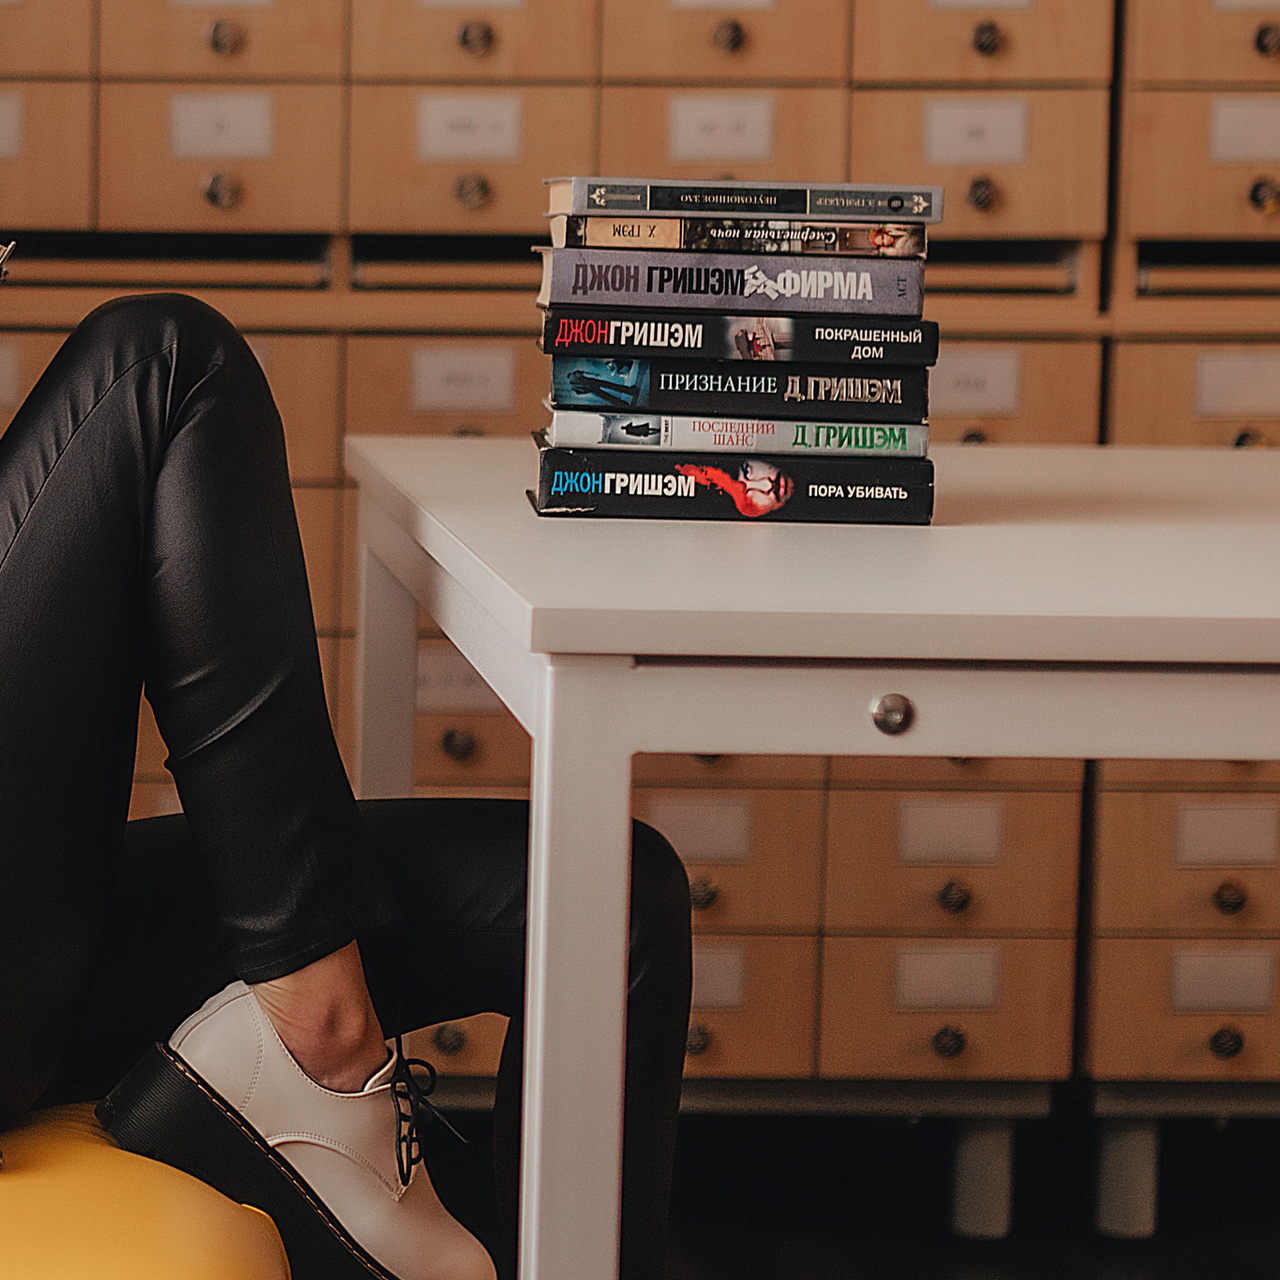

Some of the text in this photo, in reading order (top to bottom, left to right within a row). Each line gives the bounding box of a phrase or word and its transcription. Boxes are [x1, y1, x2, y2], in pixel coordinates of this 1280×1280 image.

[680, 195, 777, 205] НЕУГОМОННОЕ ЗЛО
[612, 224, 641, 238] ГРЭМ
[709, 227, 836, 244] Смертельная ночь
[572, 263, 746, 296] ДЖОН ГРИШЭМ
[777, 269, 873, 301] ФИРМА
[555, 318, 703, 349] ДЖОН ГРИШЭМ
[814, 327, 922, 344] ПОКРАШЕННЫЙ
[851, 345, 884, 360] ДОМ
[659, 373, 778, 394] ПРИЗНАНИЕ
[692, 420, 775, 435] ПОСЛЕДНИЙ
[713, 433, 754, 447] ШАНС
[550, 471, 696, 497] ДЖОН ГРИШЭМ
[808, 484, 908, 500] ПОРА УБИВАТЬ
